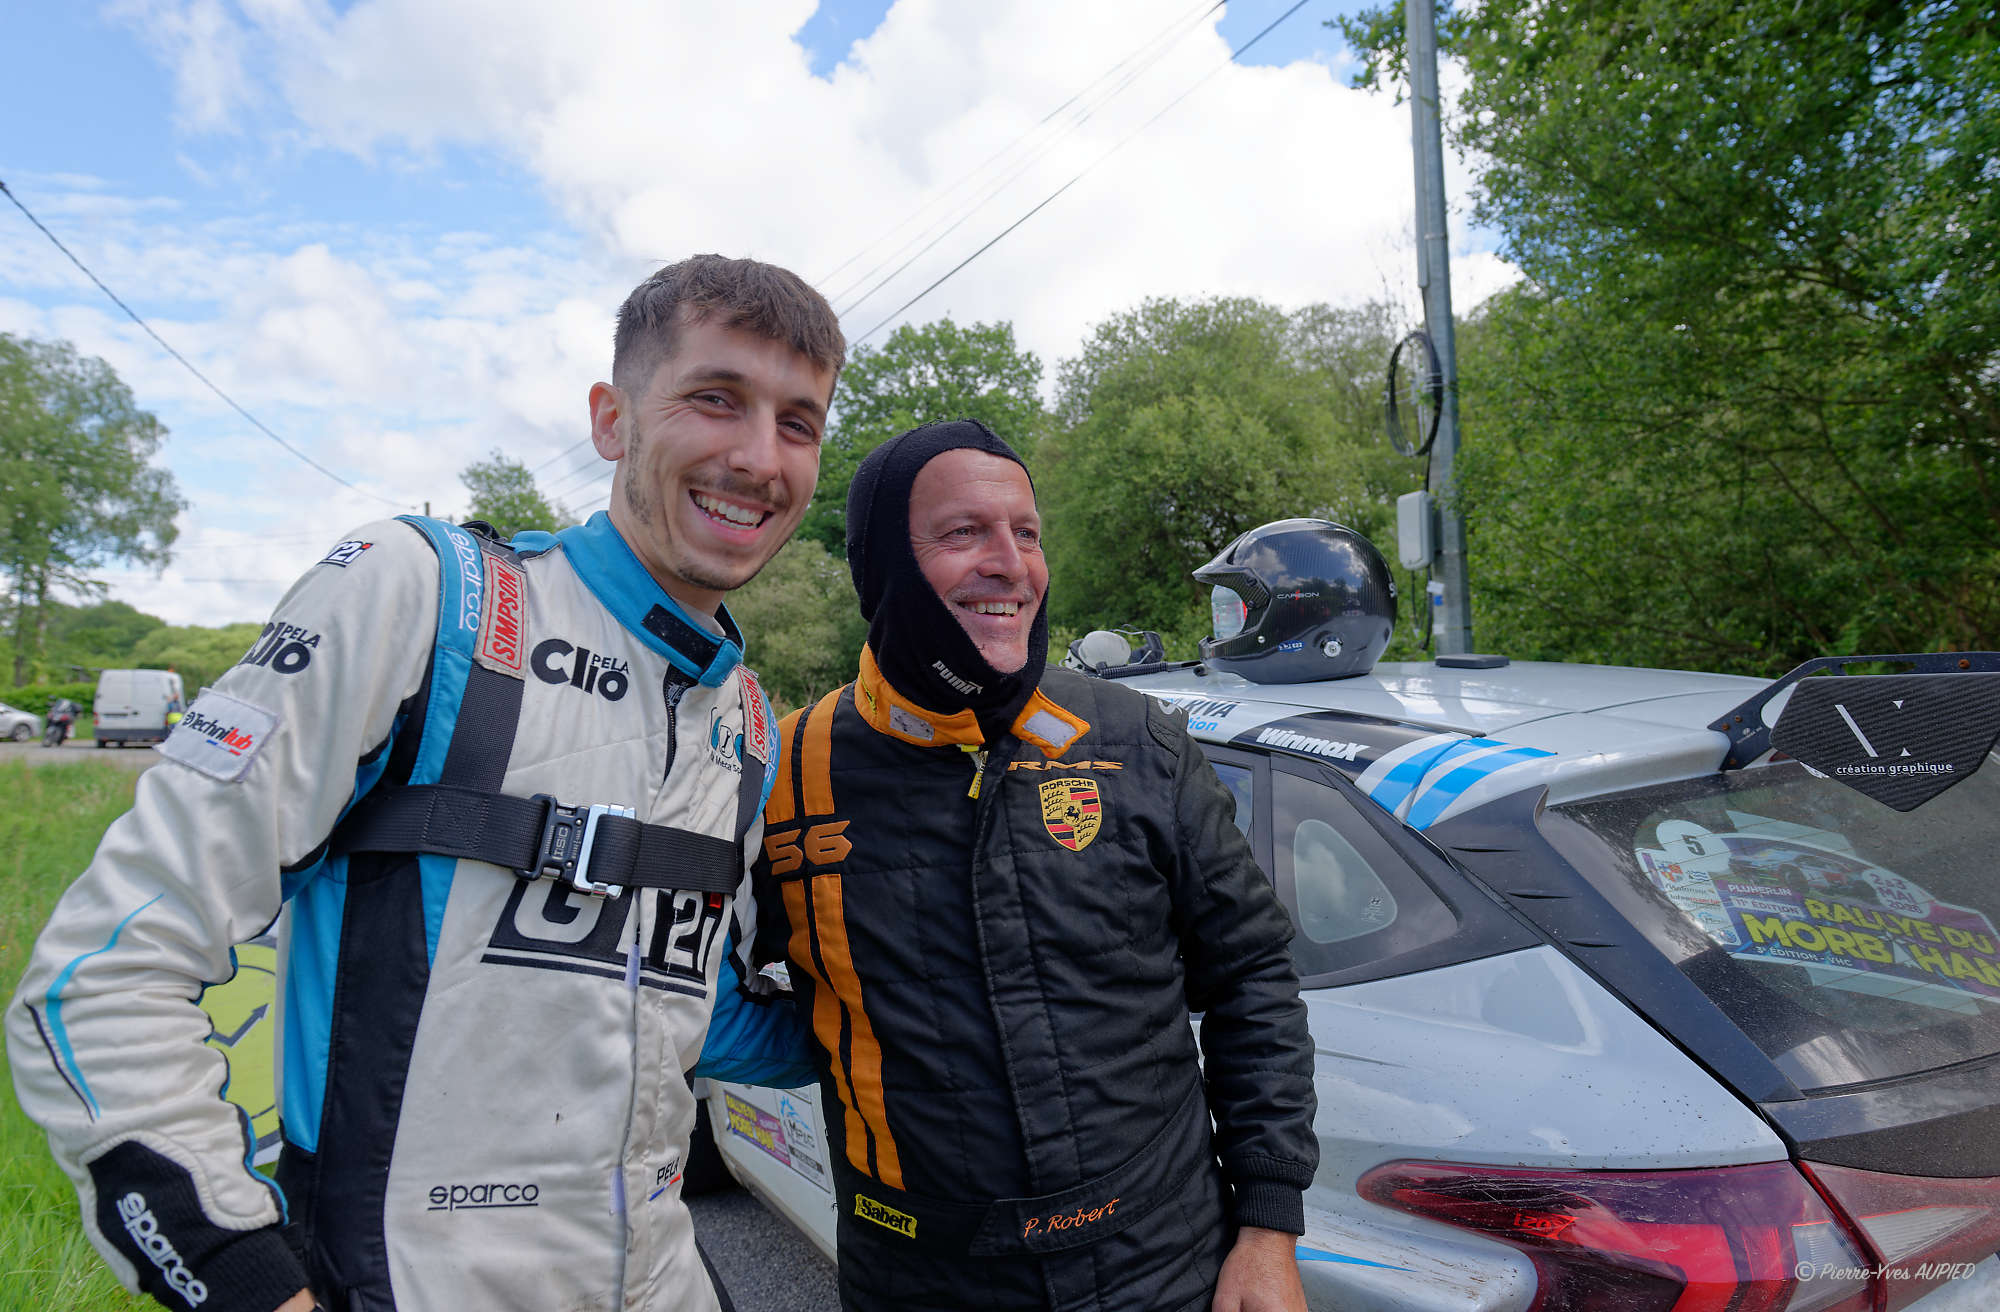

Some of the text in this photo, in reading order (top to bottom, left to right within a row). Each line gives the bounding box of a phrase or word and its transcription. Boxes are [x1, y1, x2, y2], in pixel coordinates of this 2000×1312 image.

[450, 532, 482, 632] sparco
[492, 565, 519, 661] SIMPSON
[280, 625, 321, 648] PELA
[591, 654, 630, 674] PELA
[1836, 762, 1953, 776] création graphique
[1041, 780, 1095, 793] PORSCHE
[764, 820, 852, 876] 56
[1681, 834, 1706, 856] 5
[1804, 898, 1995, 955] RALLYE DU
[429, 1183, 539, 1211] sparco
[1024, 1198, 1121, 1239] P. Robert
[121, 1191, 208, 1304] sparco
